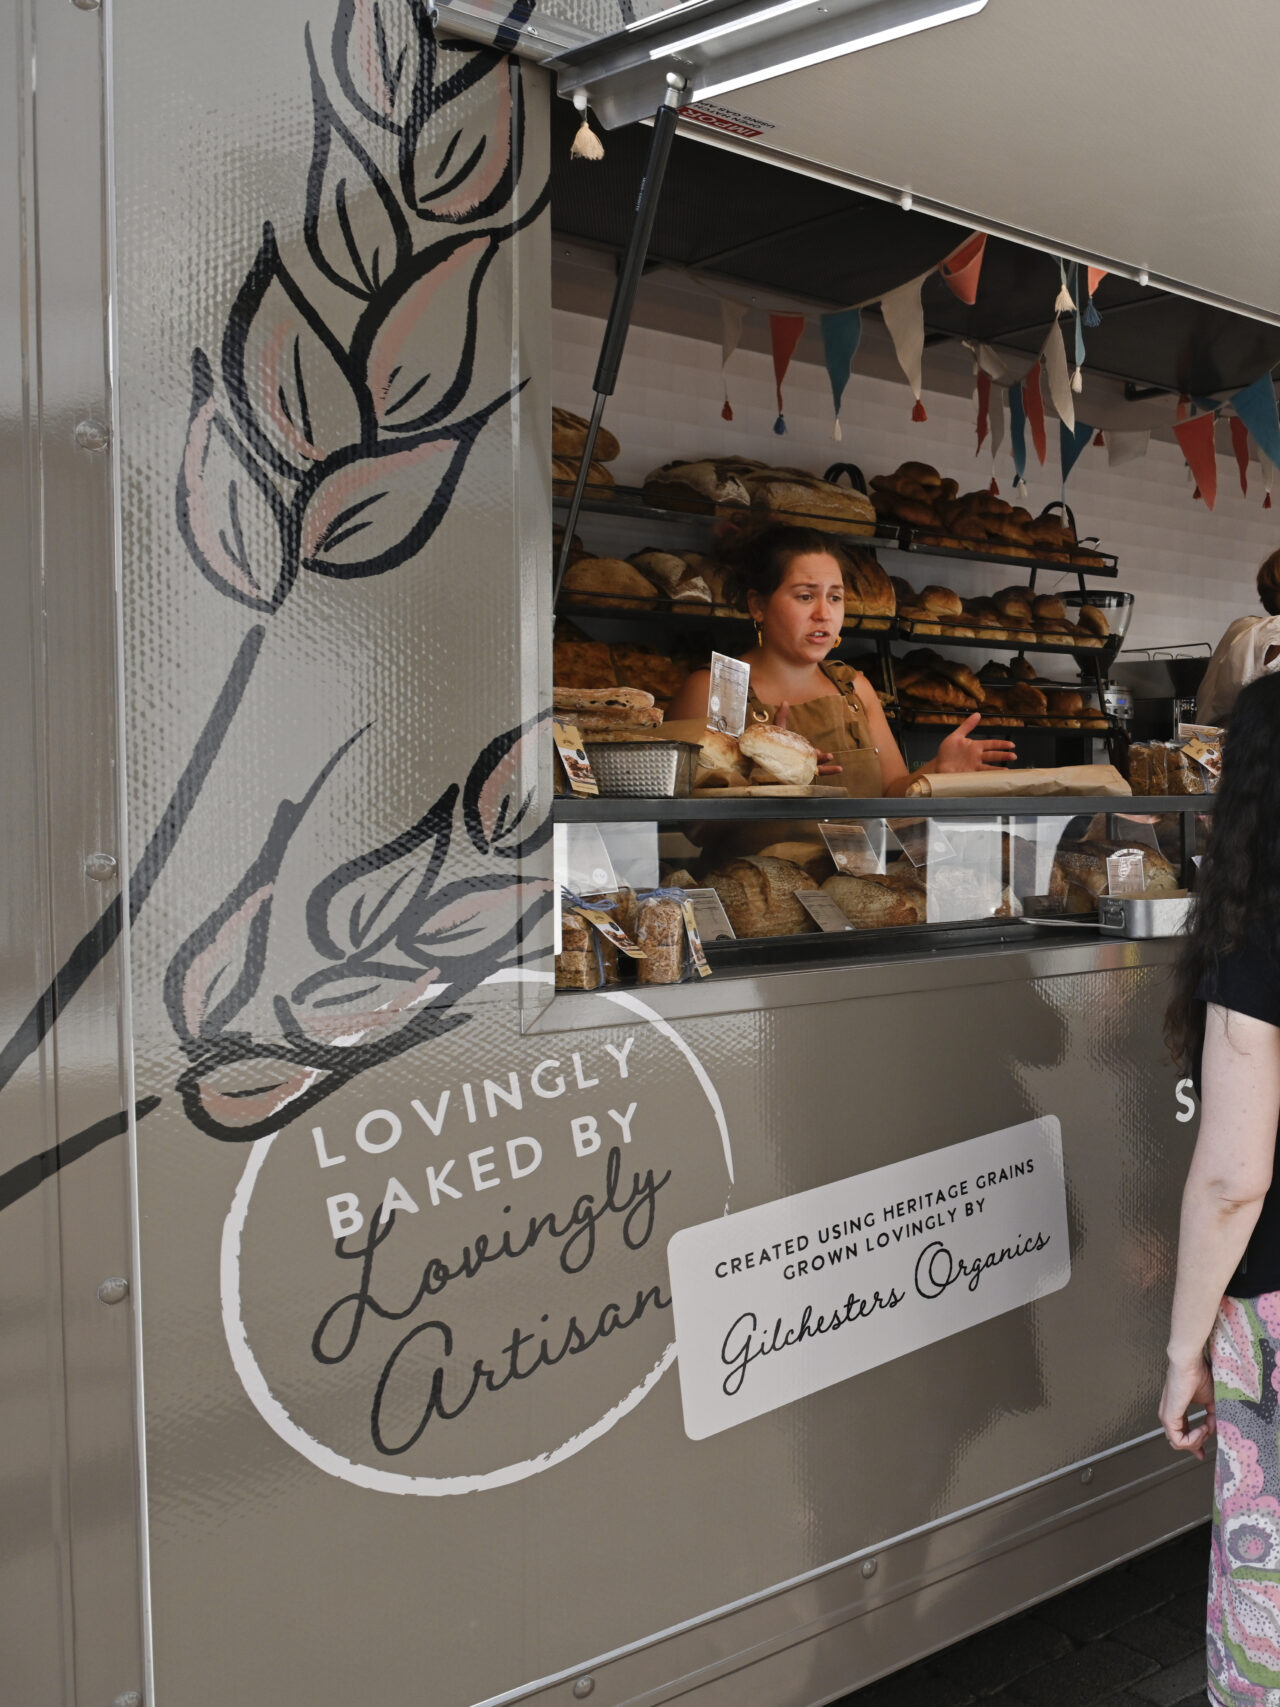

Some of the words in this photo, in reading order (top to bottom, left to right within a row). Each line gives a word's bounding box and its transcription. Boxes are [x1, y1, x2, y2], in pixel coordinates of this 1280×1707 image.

[682, 109, 756, 136] IMPOR
[719, 107, 741, 117] GAS
[732, 117, 762, 129] OPEN
[743, 116, 776, 129] USING
[312, 1037, 635, 1169] LOVINGLY
[326, 1136, 543, 1239] BAKED
[570, 1102, 638, 1158] BY
[714, 1235, 809, 1279] CREATED
[817, 1212, 876, 1244] USING
[883, 1180, 969, 1223] HERITAGE
[975, 1159, 1035, 1190] GRAINS
[312, 1146, 672, 1364] Lovingly
[783, 1242, 858, 1280] GROWN
[865, 1209, 957, 1253] LOVINGLY
[965, 1197, 986, 1217] BY
[371, 1285, 674, 1456] Artisan
[721, 1287, 905, 1396] Gilchesters
[914, 1231, 1051, 1299] Organics
